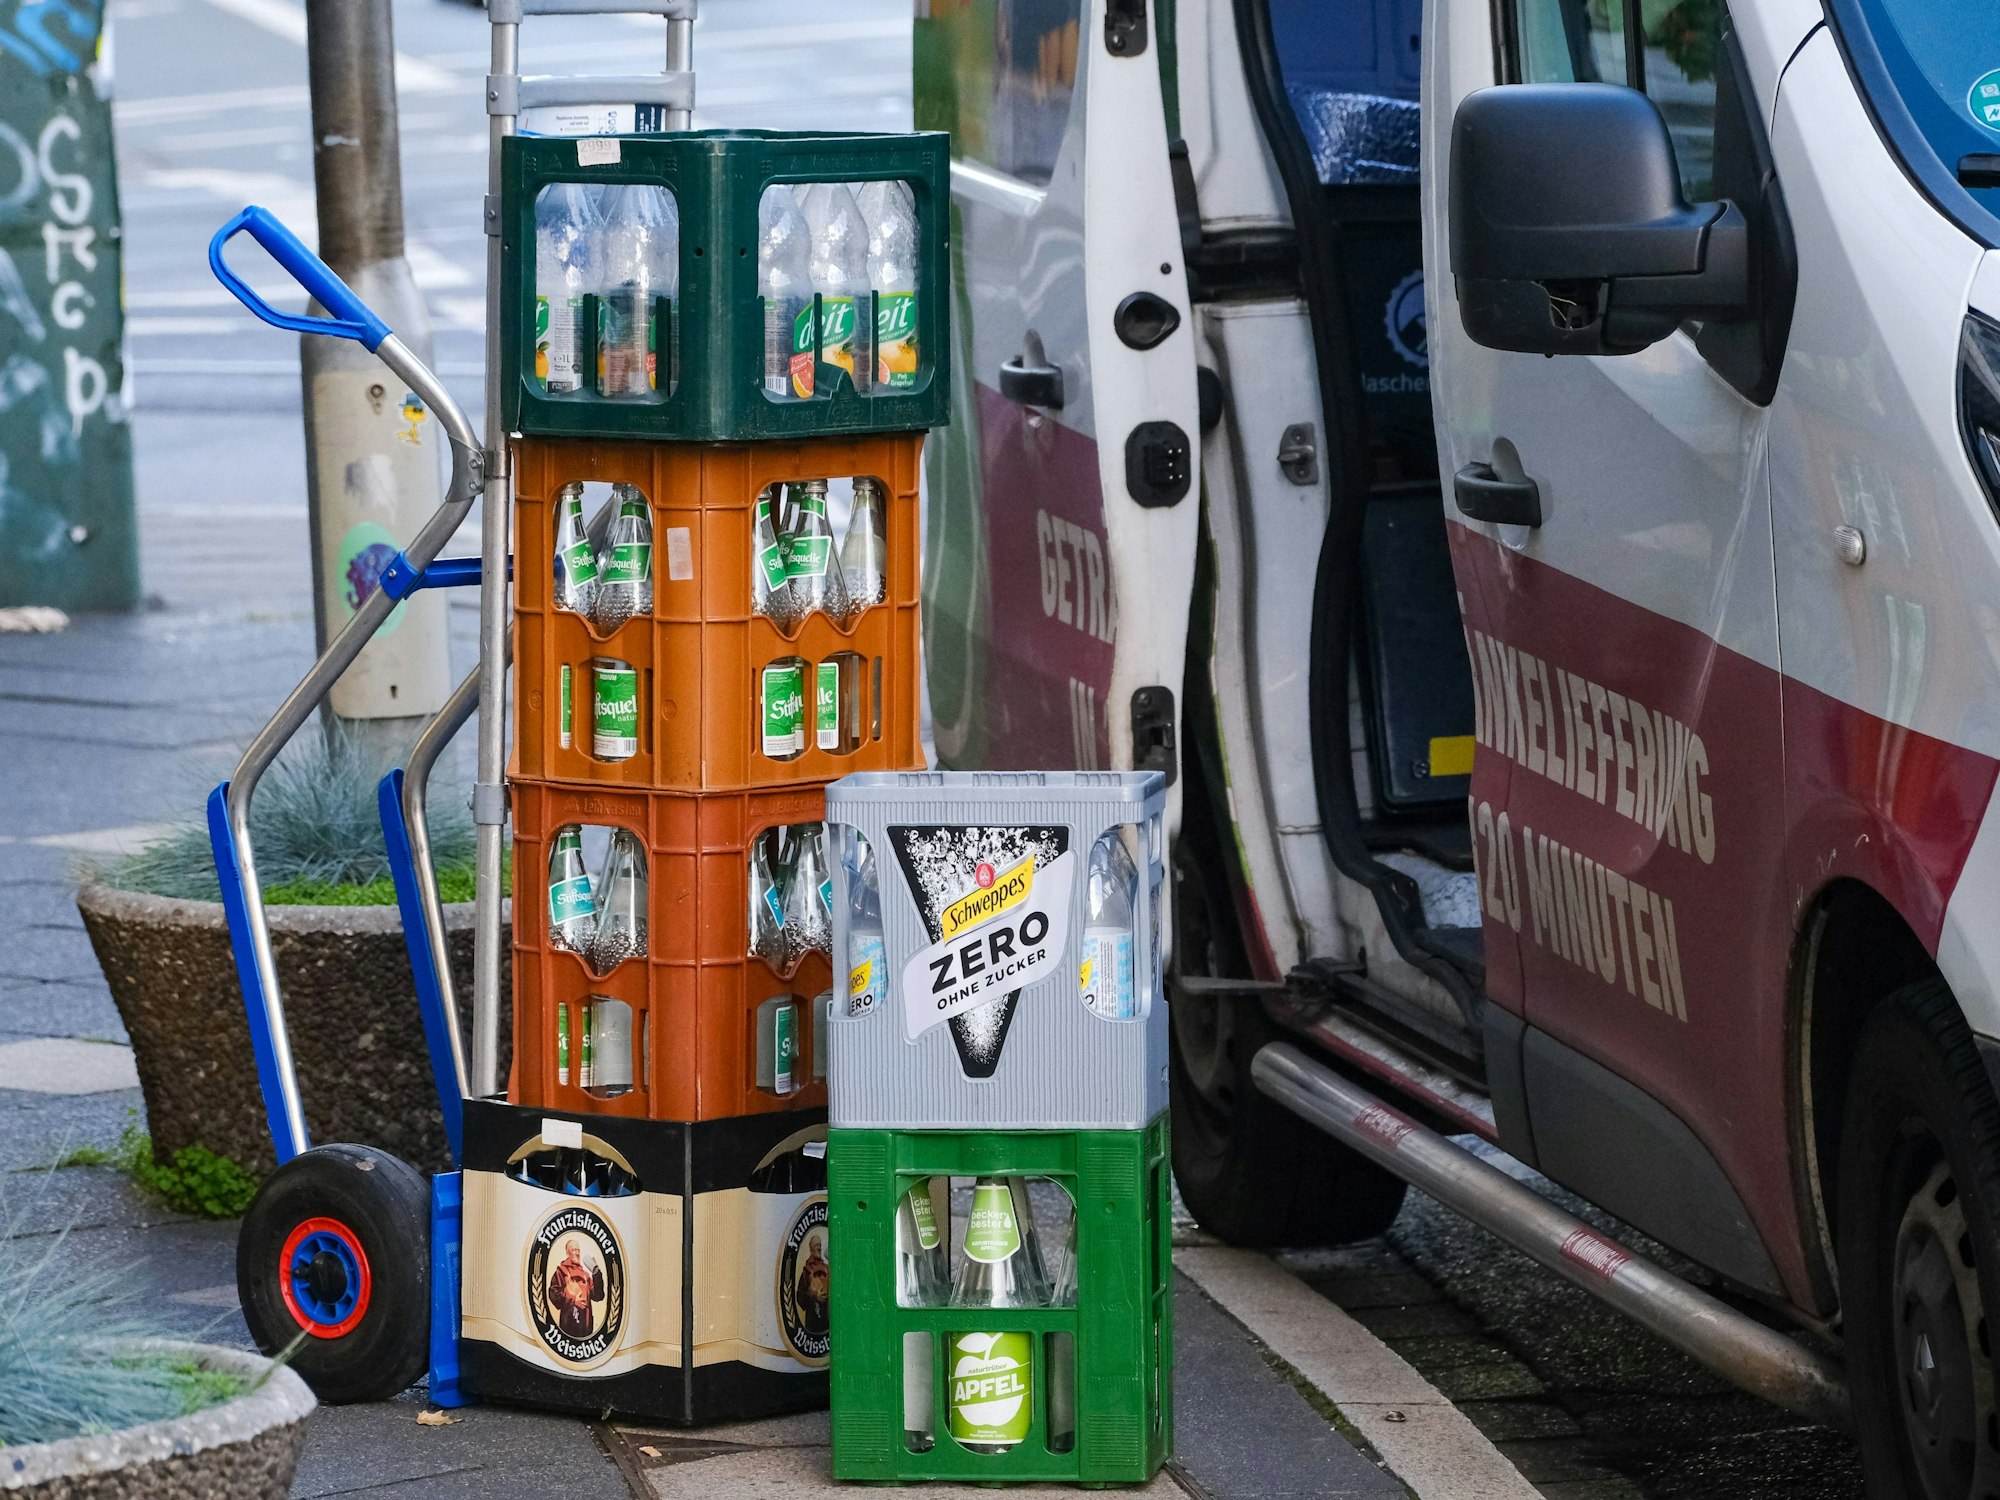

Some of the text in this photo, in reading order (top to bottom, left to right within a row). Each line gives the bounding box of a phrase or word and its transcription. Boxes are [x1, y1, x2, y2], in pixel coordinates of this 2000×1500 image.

[949, 872, 1026, 931] Schweppes
[1523, 826, 1688, 1023] MINUTEN
[929, 911, 1050, 994] ZERO
[937, 949, 1047, 1010] OHNE ZUCKER
[537, 1210, 616, 1256] Franziskaner
[544, 1323, 607, 1360] Weissbier
[954, 1373, 1025, 1402] APFEL
[968, 1363, 1008, 1375] naturtrüber
